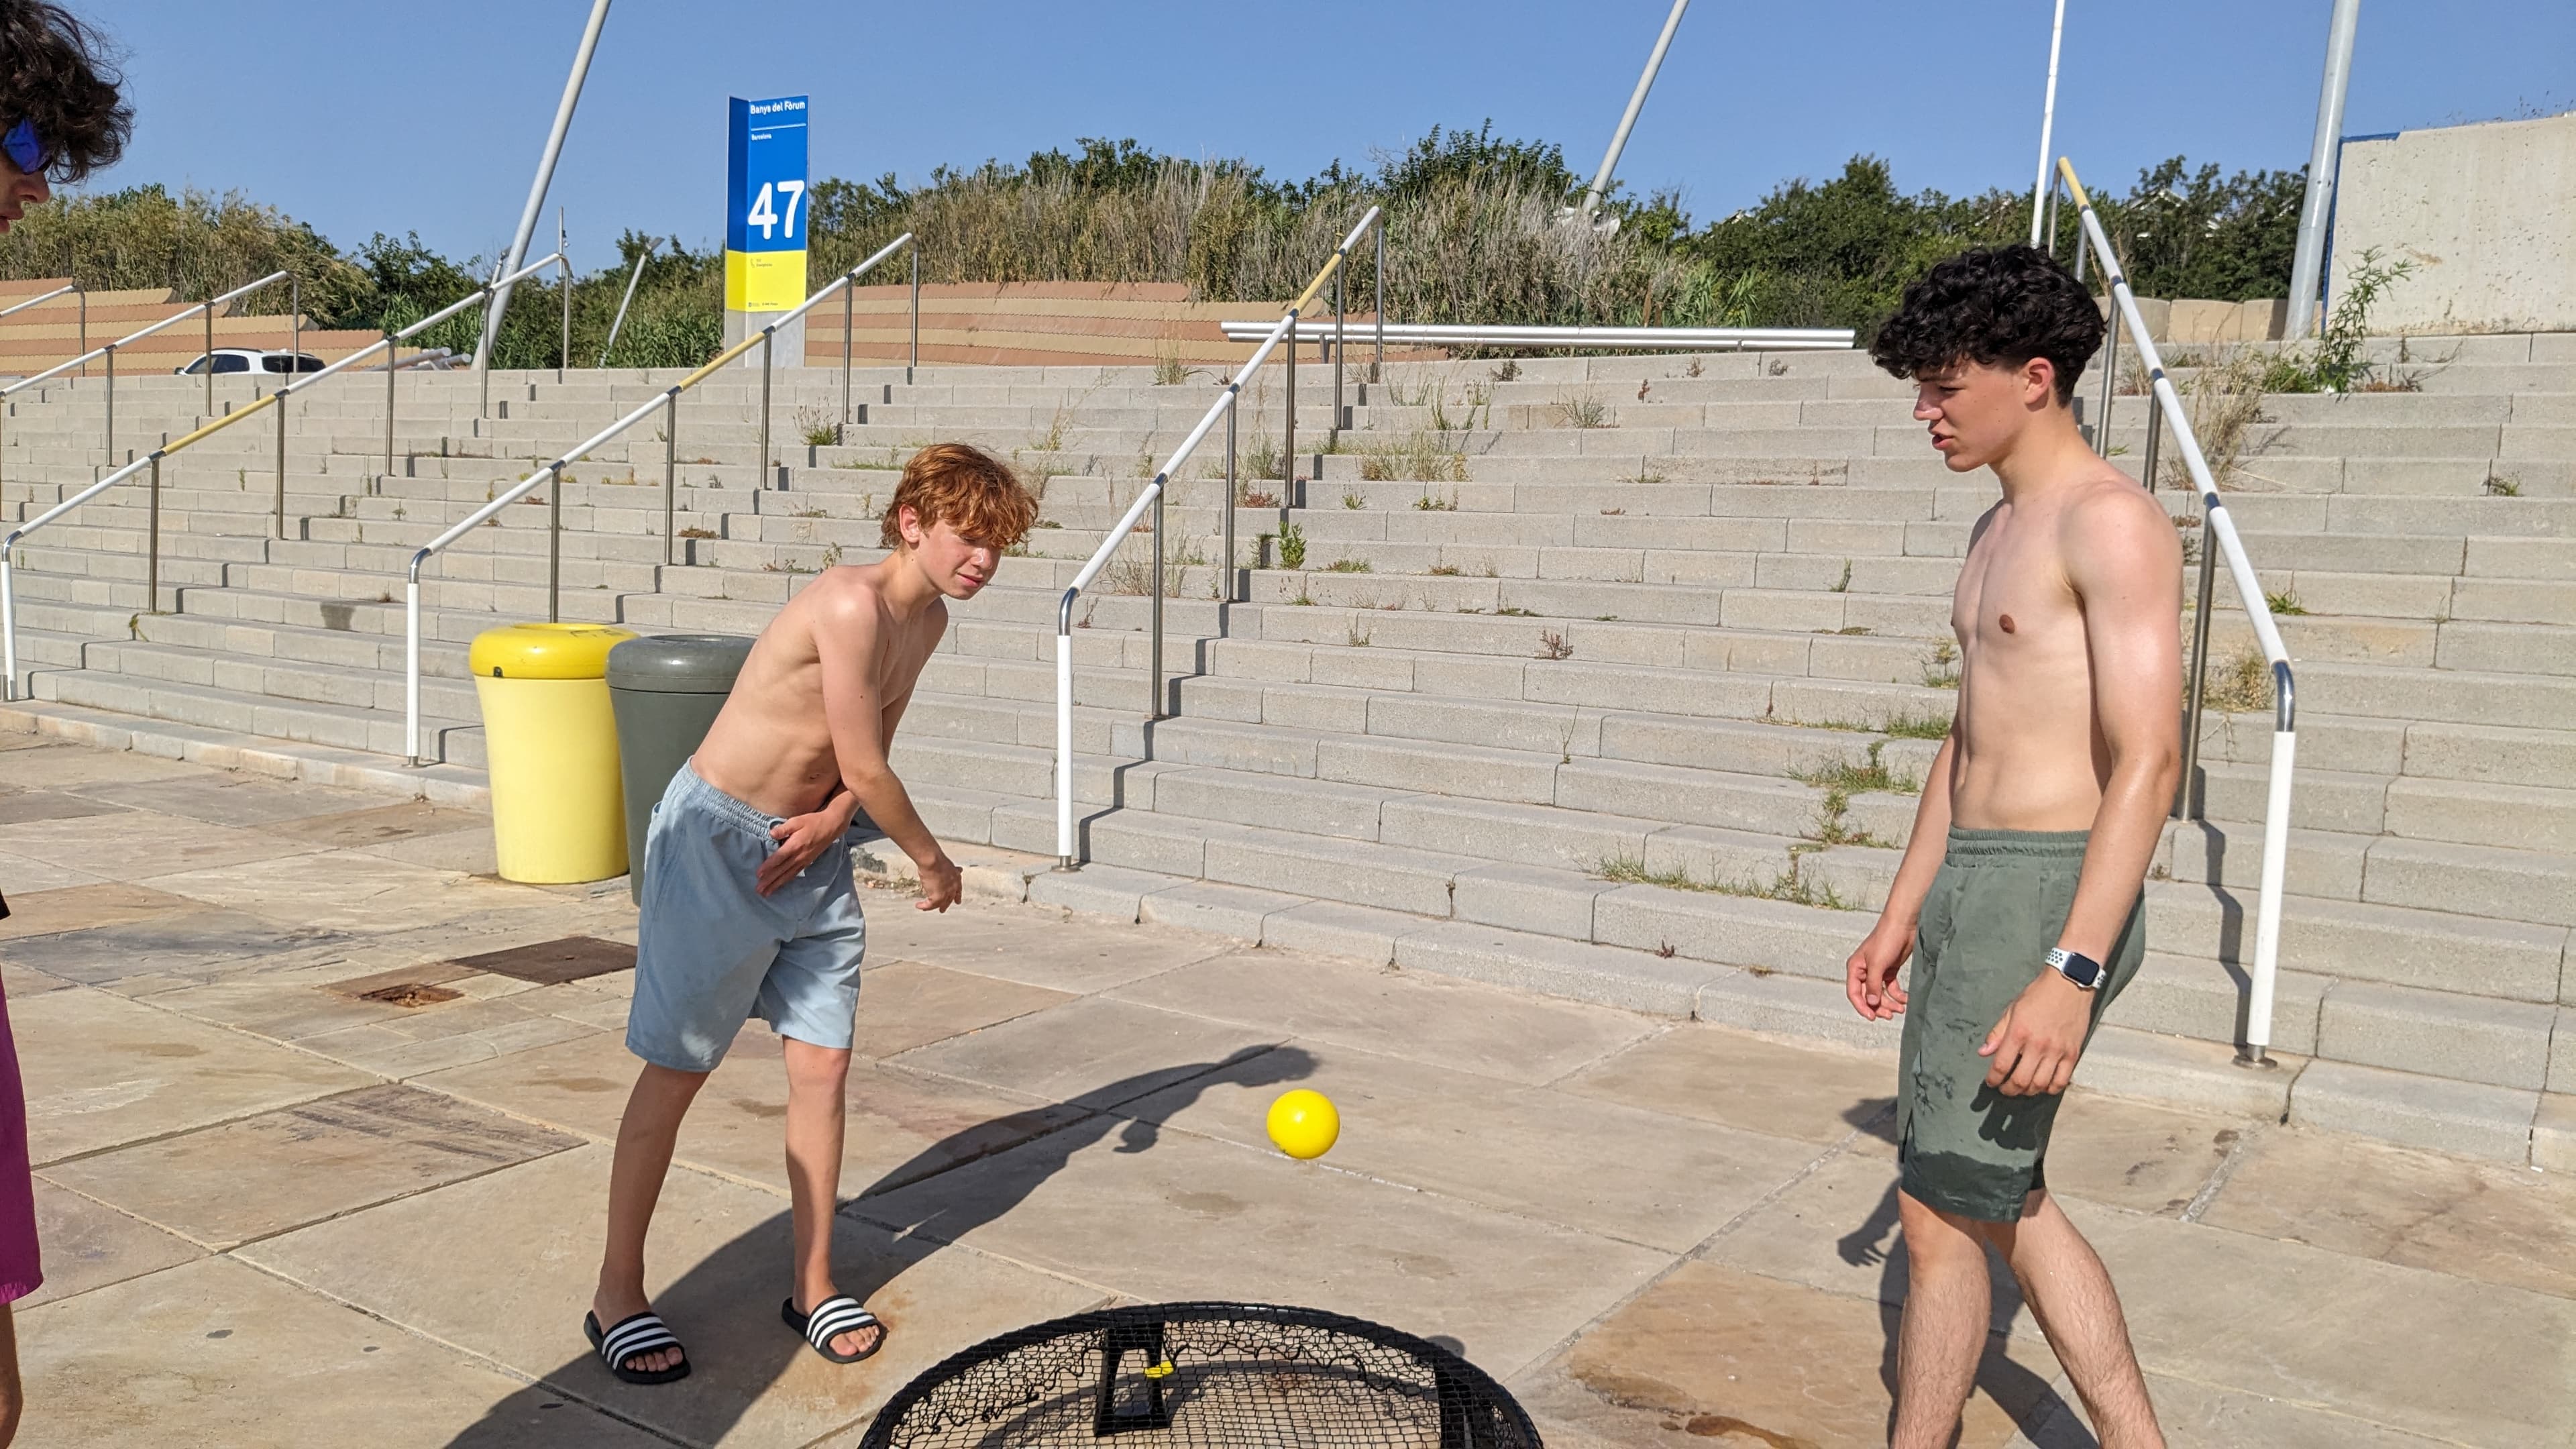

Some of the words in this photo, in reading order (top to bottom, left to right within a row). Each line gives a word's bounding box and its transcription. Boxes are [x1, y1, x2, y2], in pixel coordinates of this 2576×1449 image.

[751, 105, 771, 115] Banys
[772, 102, 783, 112] del
[748, 180, 805, 239] 47
